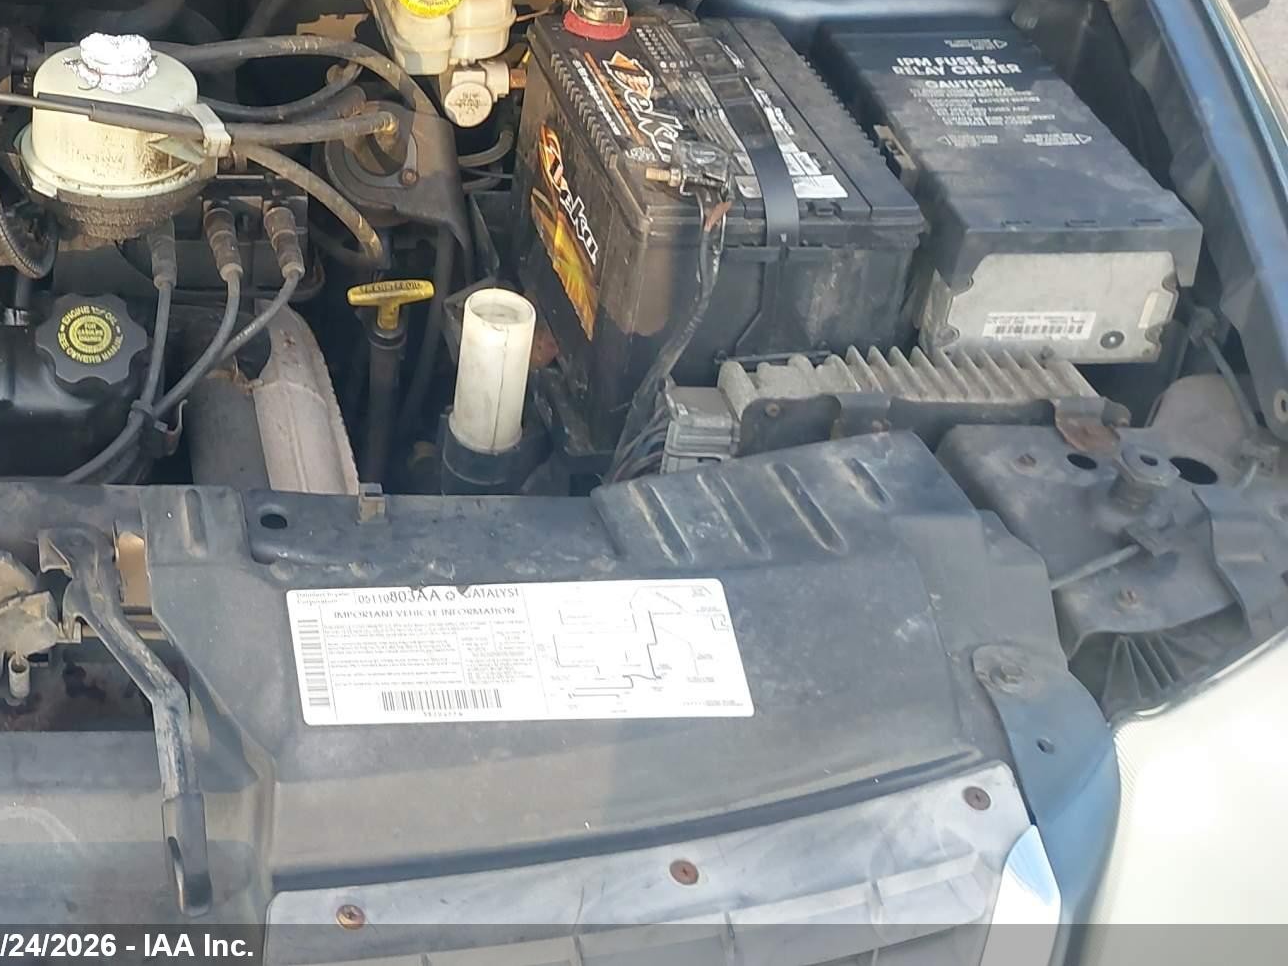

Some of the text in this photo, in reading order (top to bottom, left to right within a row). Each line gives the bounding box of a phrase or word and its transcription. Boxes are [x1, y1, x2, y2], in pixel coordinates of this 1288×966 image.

[896, 56, 997, 67] IPM FUSE &
[891, 63, 1022, 76] RELAY CENTER
[924, 79, 1007, 88] CAUTION!
[334, 606, 516, 619] IMPORTANT VEHICLE INFORMATION
